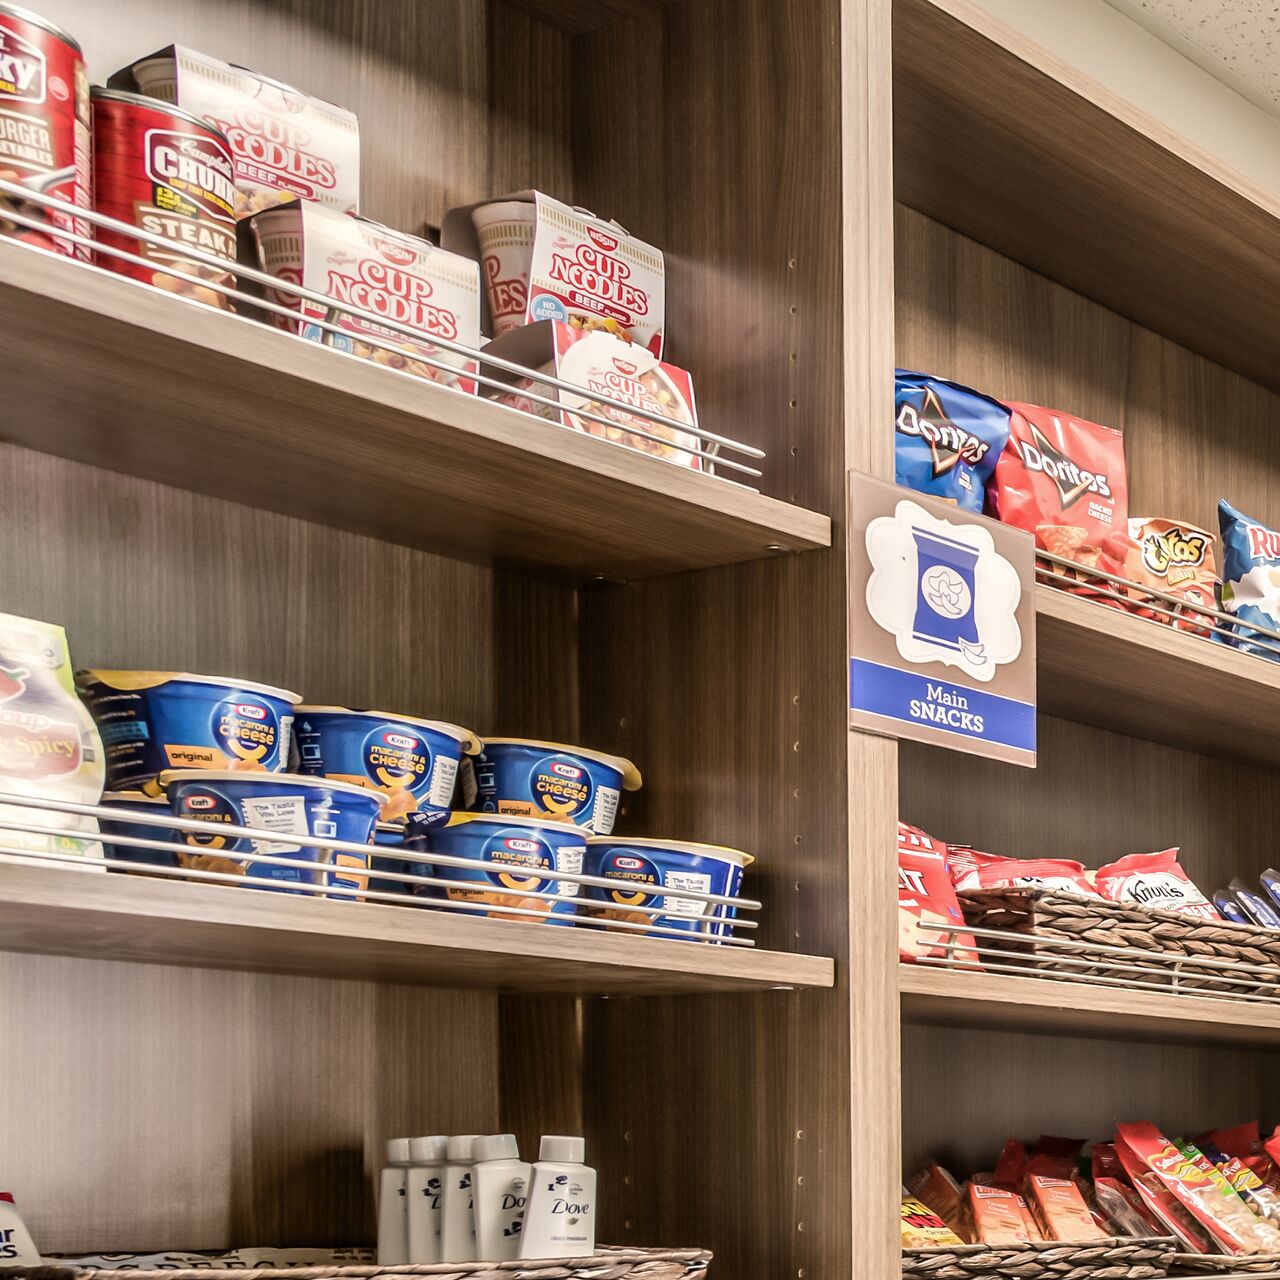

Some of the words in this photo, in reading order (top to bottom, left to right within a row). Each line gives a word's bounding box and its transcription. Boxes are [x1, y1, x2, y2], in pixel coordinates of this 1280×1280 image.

[235, 105, 310, 149] CUP
[236, 163, 276, 184] BEEF
[142, 215, 228, 249] STEAK
[576, 244, 631, 284] CUP
[358, 258, 433, 301] CUP
[549, 253, 650, 316] NOODLES
[327, 270, 458, 340] NOODLES
[575, 293, 605, 313] BEEF
[536, 308, 564, 321] ADDED
[605, 371, 647, 397] CUP
[896, 405, 989, 463] Doritos
[1021, 441, 1111, 499] Doritos
[927, 684, 967, 709] Main
[242, 706, 262, 717] Kraft
[910, 699, 985, 733] SNACKS
[220, 715, 268, 733] macaroni
[387, 735, 414, 748] Kraft
[171, 751, 213, 764] original
[371, 745, 417, 761] macaroni
[557, 766, 577, 777] Kraft
[538, 774, 582, 790] macaroni
[501, 806, 531, 816] original
[511, 840, 532, 851] Kraft
[617, 858, 638, 869] Kraft
[502, 1194, 526, 1210] Do
[552, 1199, 589, 1215] Dove
